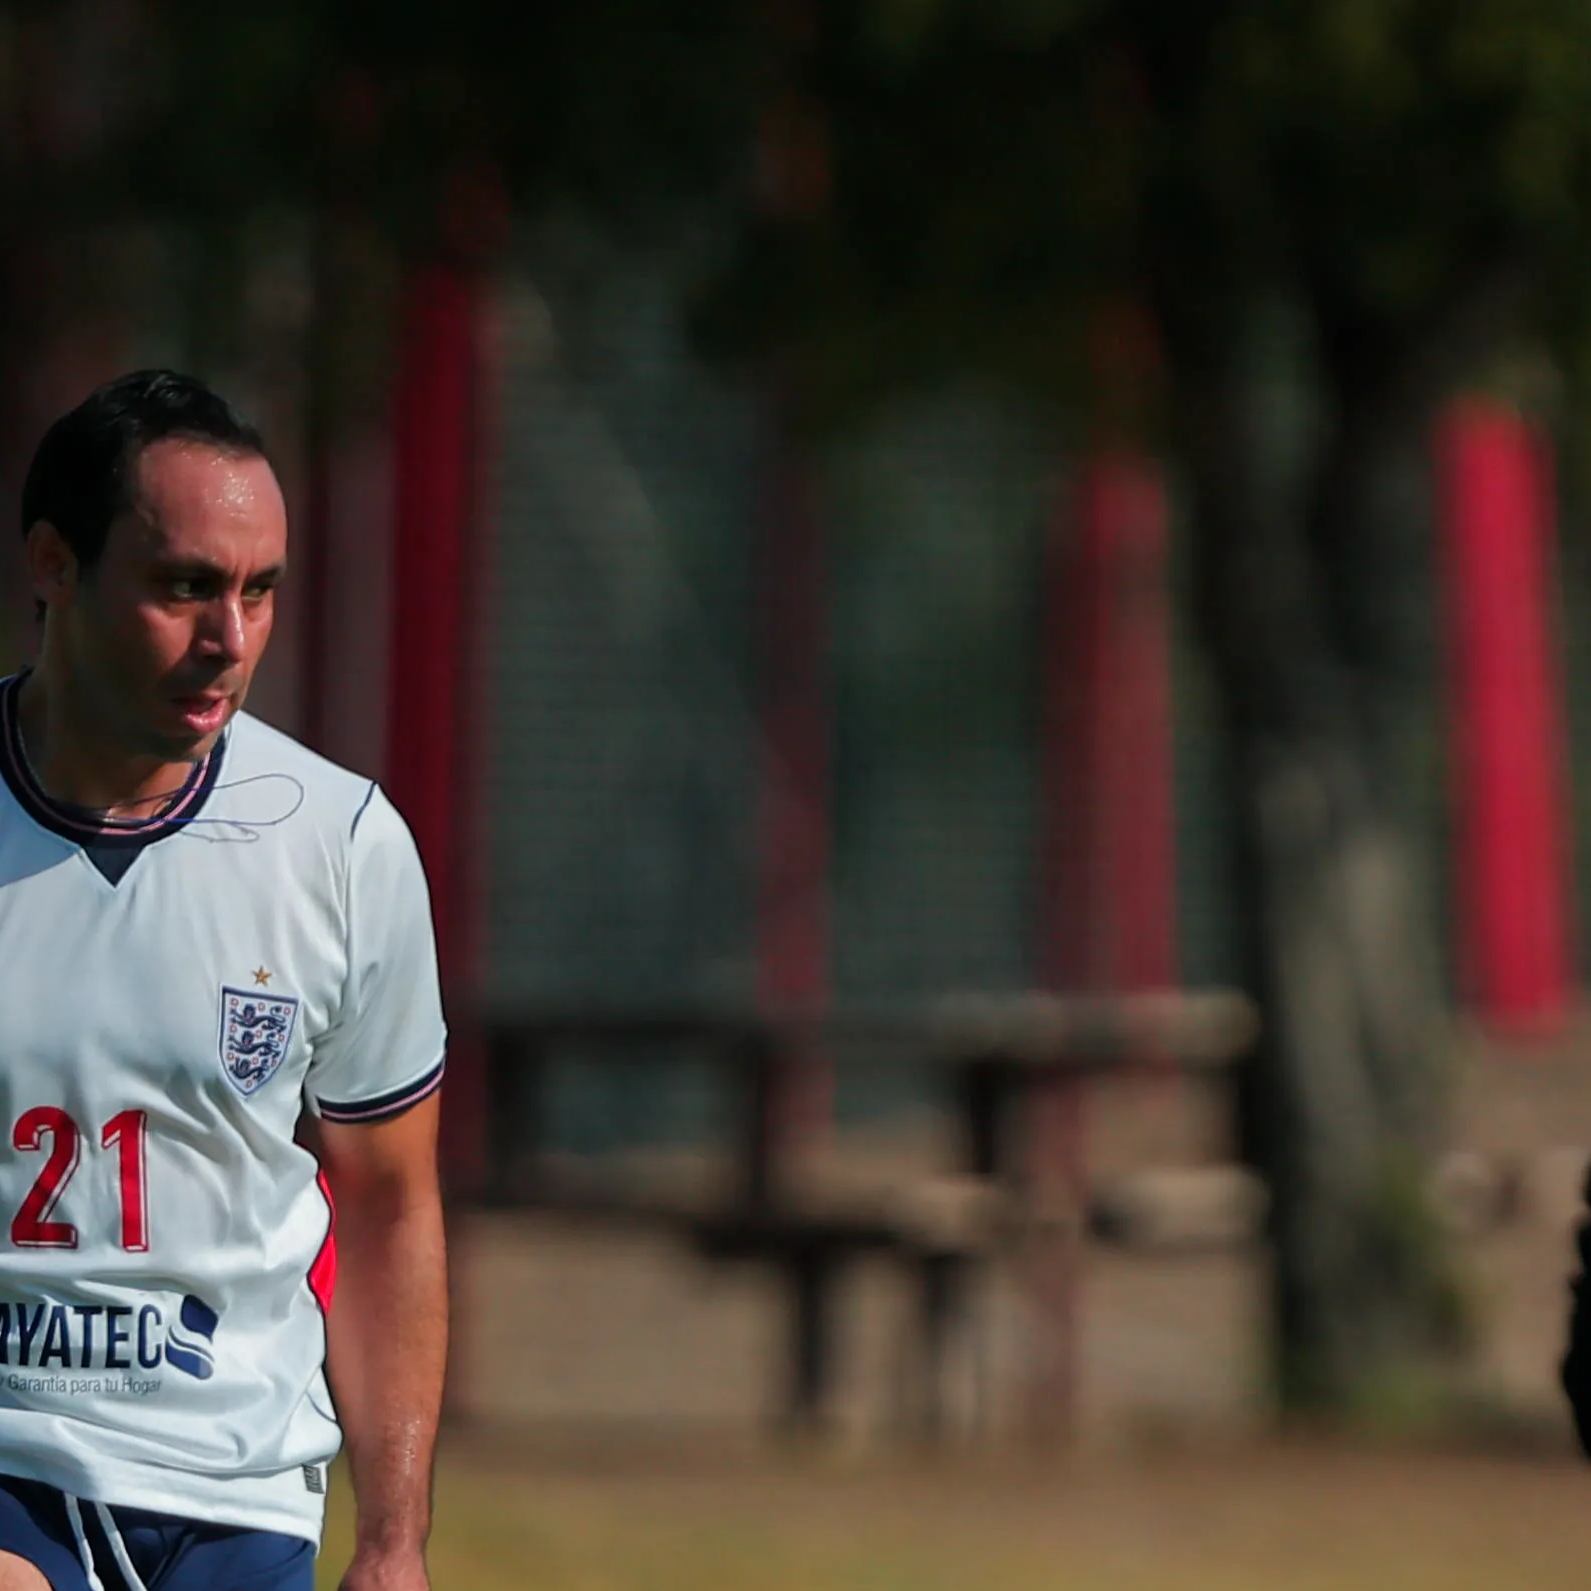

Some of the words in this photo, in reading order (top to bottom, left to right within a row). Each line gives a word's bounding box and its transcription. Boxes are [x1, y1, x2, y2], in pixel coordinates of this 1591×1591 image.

[11, 1106, 149, 1253] 21
[70, 1377, 101, 1396] para
[105, 1376, 118, 1392] tu
[121, 1376, 161, 1395] Hogar
